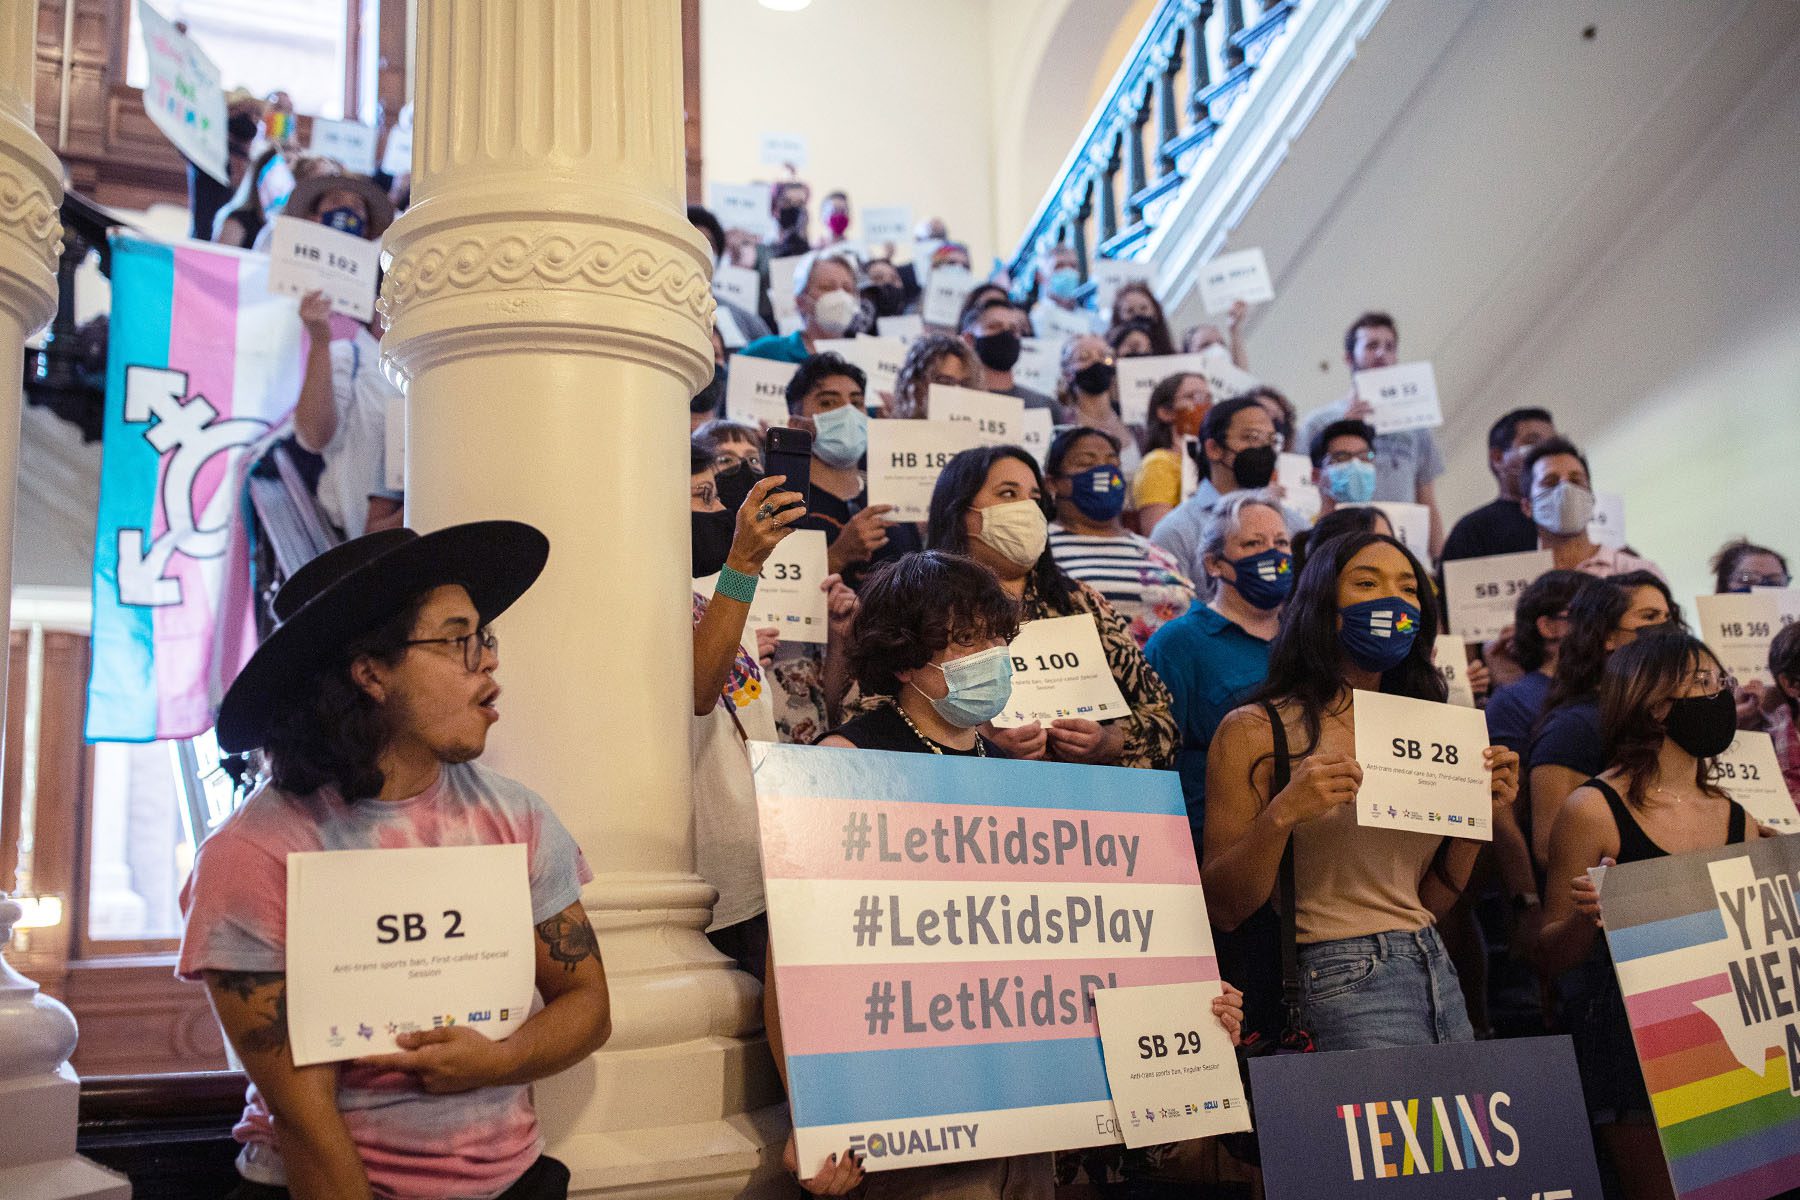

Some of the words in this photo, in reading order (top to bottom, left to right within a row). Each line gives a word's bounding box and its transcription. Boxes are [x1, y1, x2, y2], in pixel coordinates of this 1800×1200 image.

[294, 243, 320, 261] HB
[979, 418, 1007, 435] 185
[891, 452, 917, 468] HB
[774, 563, 802, 580] 33
[1475, 582, 1500, 598] SB
[1720, 622, 1743, 637] HB
[1011, 656, 1028, 672] B
[1035, 652, 1080, 671] 100
[1392, 737, 1422, 760] SB
[1431, 743, 1459, 765] 28
[1717, 762, 1736, 778] SB
[1739, 764, 1760, 780] 32
[841, 811, 1140, 877] #LetKidsPlay
[376, 912, 427, 944] SB
[442, 910, 465, 939] 2
[852, 894, 1154, 952] #LetKidsPlay
[864, 972, 1117, 1035] #LetKidsP
[1138, 1035, 1168, 1059] SB
[1174, 1030, 1201, 1056] 29
[849, 1124, 979, 1158] EQUALITY
[1336, 1091, 1520, 1181] TEXANS
